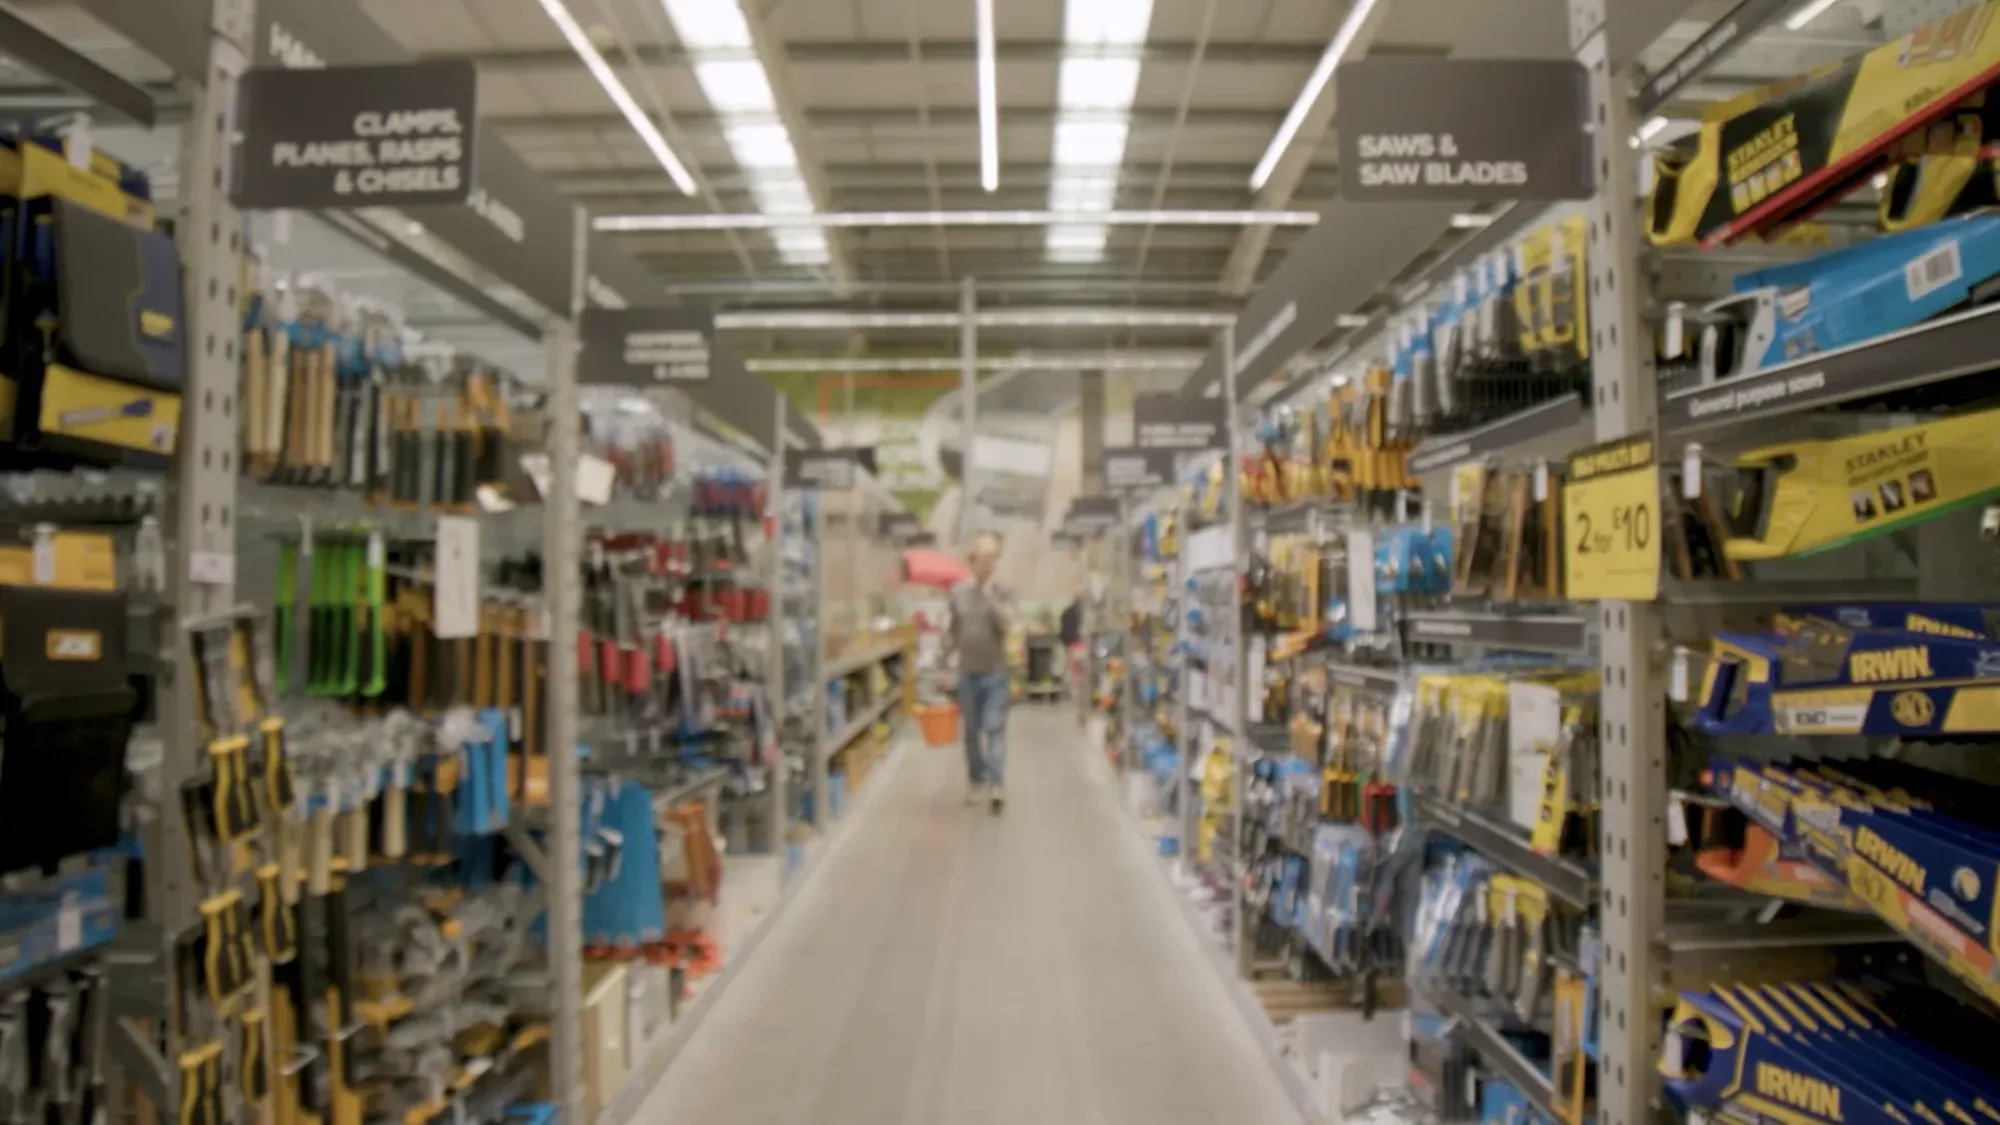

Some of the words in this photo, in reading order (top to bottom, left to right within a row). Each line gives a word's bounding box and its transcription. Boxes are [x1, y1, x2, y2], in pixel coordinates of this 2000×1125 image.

[378, 136, 463, 163] RASPS
[1358, 133, 1434, 157] SAWS
[1439, 132, 1458, 157] &
[333, 169, 354, 195] &
[356, 165, 461, 193] CHISELS
[1359, 162, 1420, 186] SAW
[1425, 161, 1528, 185] BLADES
[1689, 390, 1735, 418] General
[1737, 381, 1786, 412] purpose
[1788, 371, 1826, 395] saws
[1845, 431, 1927, 475] STANLEY
[1576, 510, 1592, 555] 2
[1851, 646, 1930, 684] IRWIN
[1854, 824, 1927, 898] IRWIN
[1756, 1061, 1842, 1121] IRWIN
